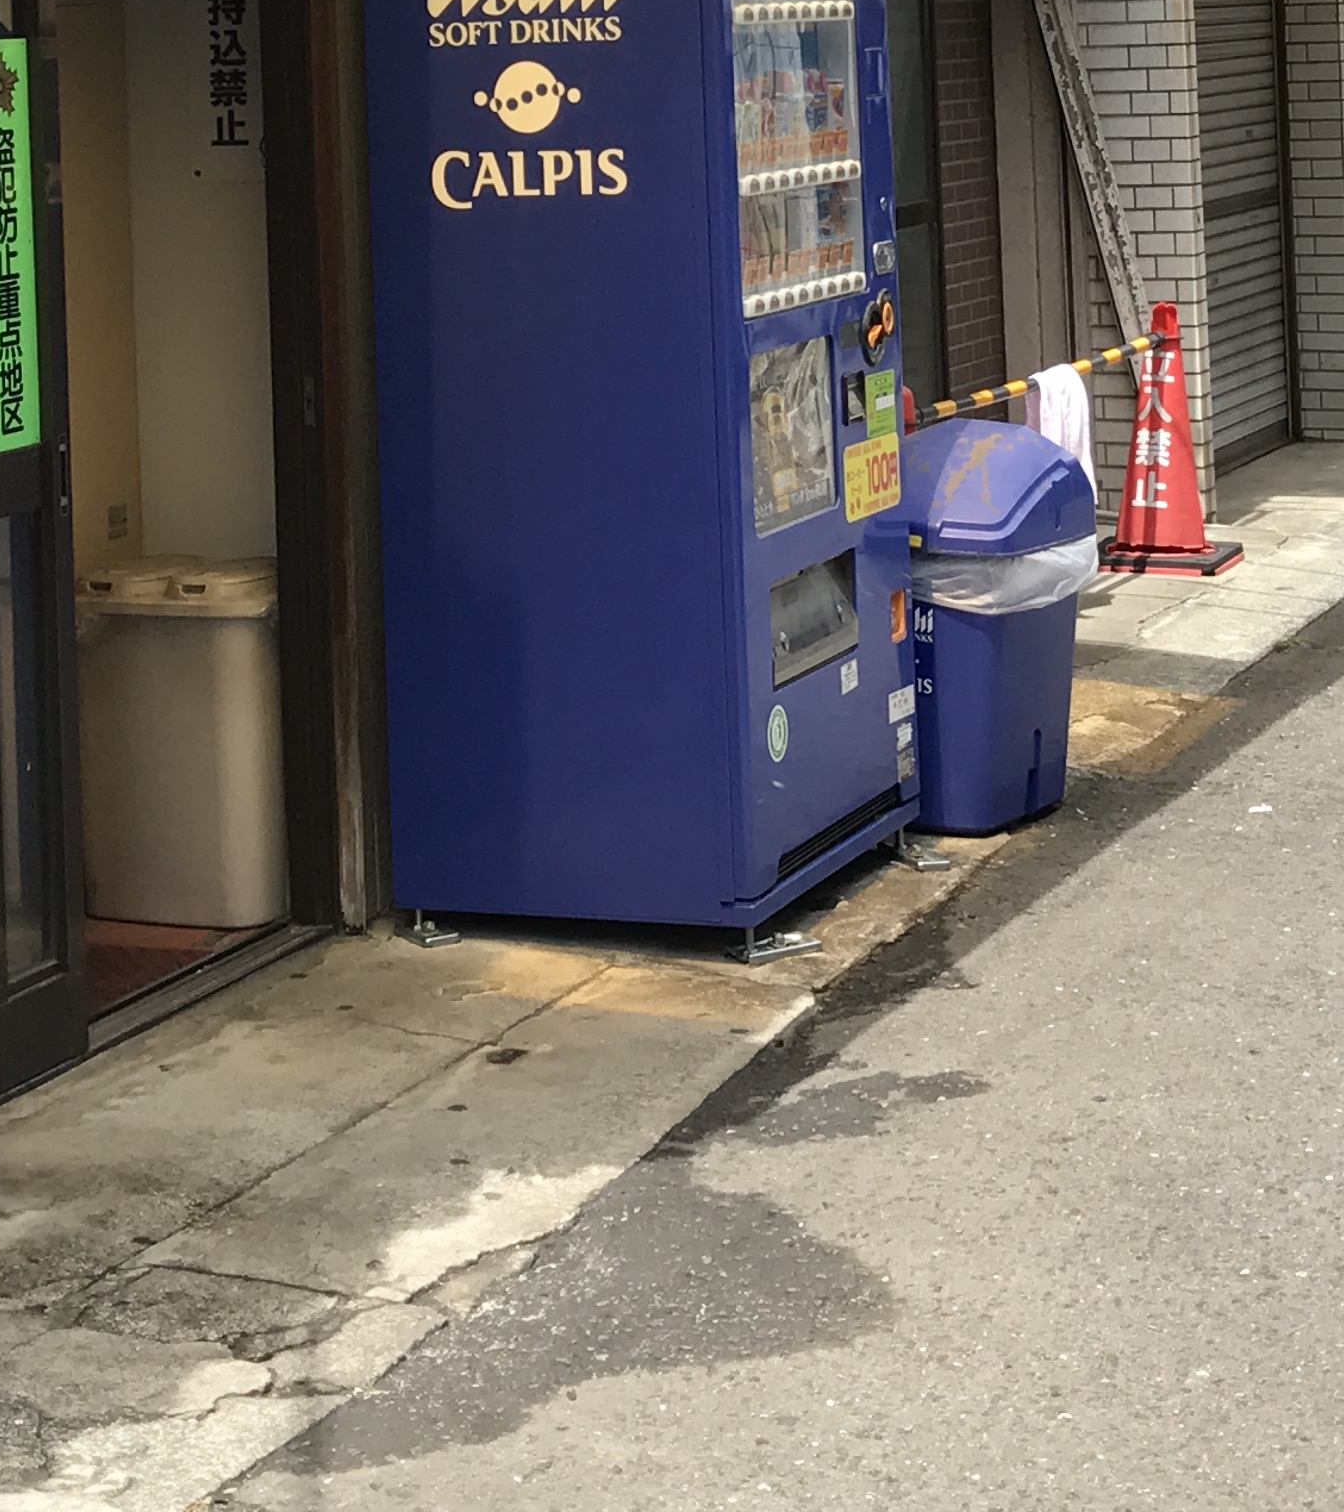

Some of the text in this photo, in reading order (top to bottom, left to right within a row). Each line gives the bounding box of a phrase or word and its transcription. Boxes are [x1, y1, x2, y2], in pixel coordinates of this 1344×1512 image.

[428, 16, 623, 48] SOFT DRINKS
[431, 148, 629, 210] CALPIS
[1131, 350, 1176, 510] 立入禁止
[865, 451, 898, 496] 100円
